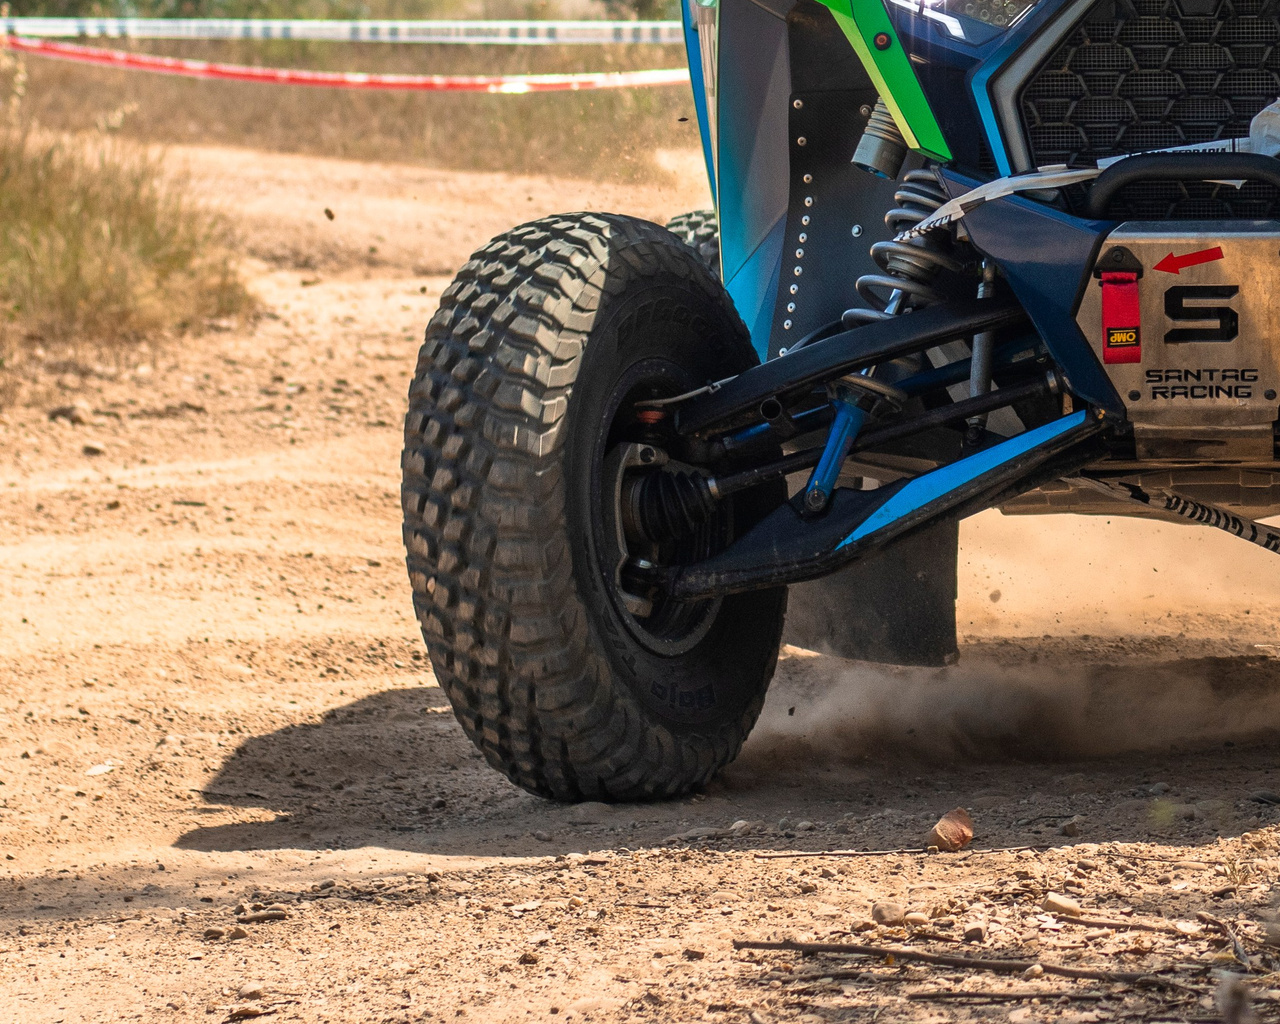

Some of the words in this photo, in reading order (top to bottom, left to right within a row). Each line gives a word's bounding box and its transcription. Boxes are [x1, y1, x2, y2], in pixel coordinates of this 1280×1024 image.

[1110, 332, 1136, 343] OMP
[1145, 368, 1259, 384] SANTAG
[1151, 385, 1252, 400] RACING
